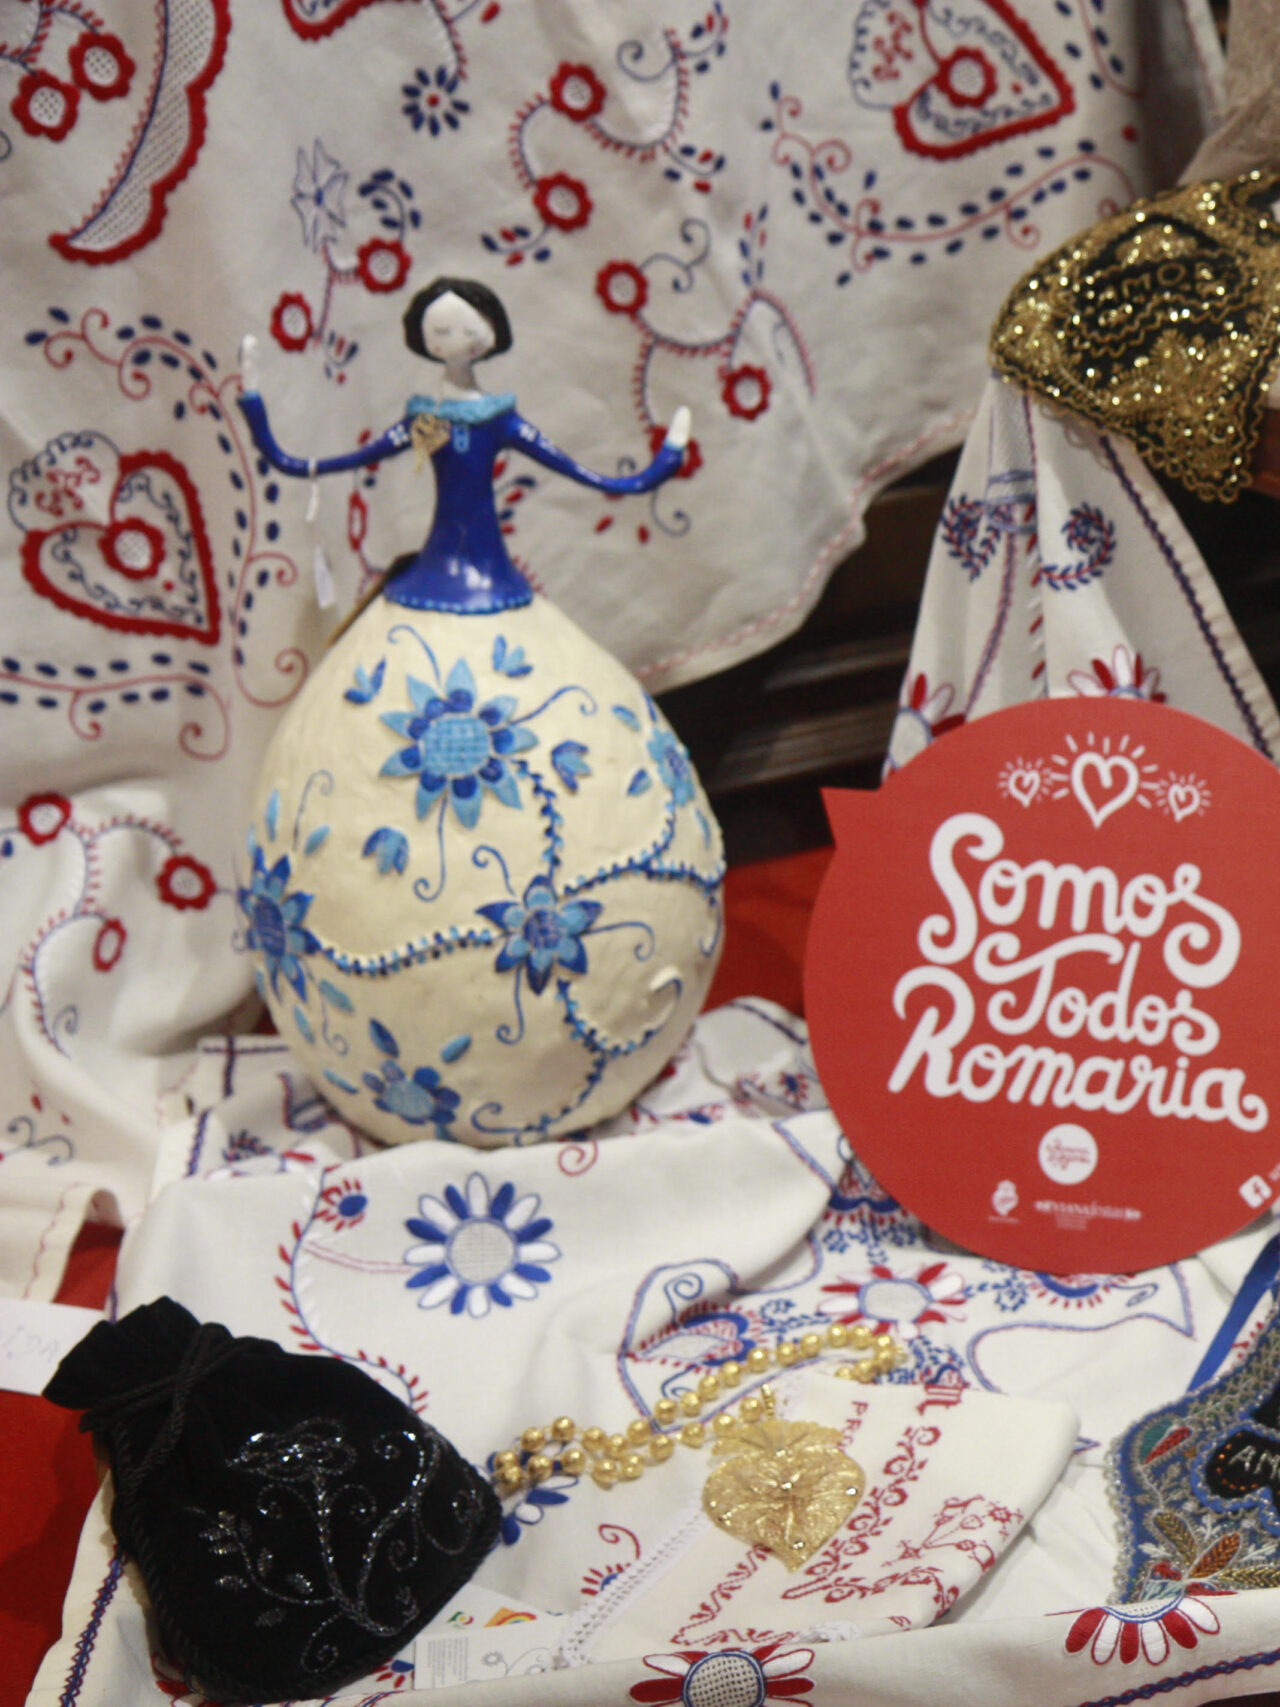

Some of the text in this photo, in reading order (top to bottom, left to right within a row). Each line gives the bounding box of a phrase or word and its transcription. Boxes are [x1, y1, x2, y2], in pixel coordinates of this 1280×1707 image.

[918, 812, 1241, 989] Somos
[887, 965, 1268, 1132] Romaria
[974, 932, 1220, 1056] Todos
